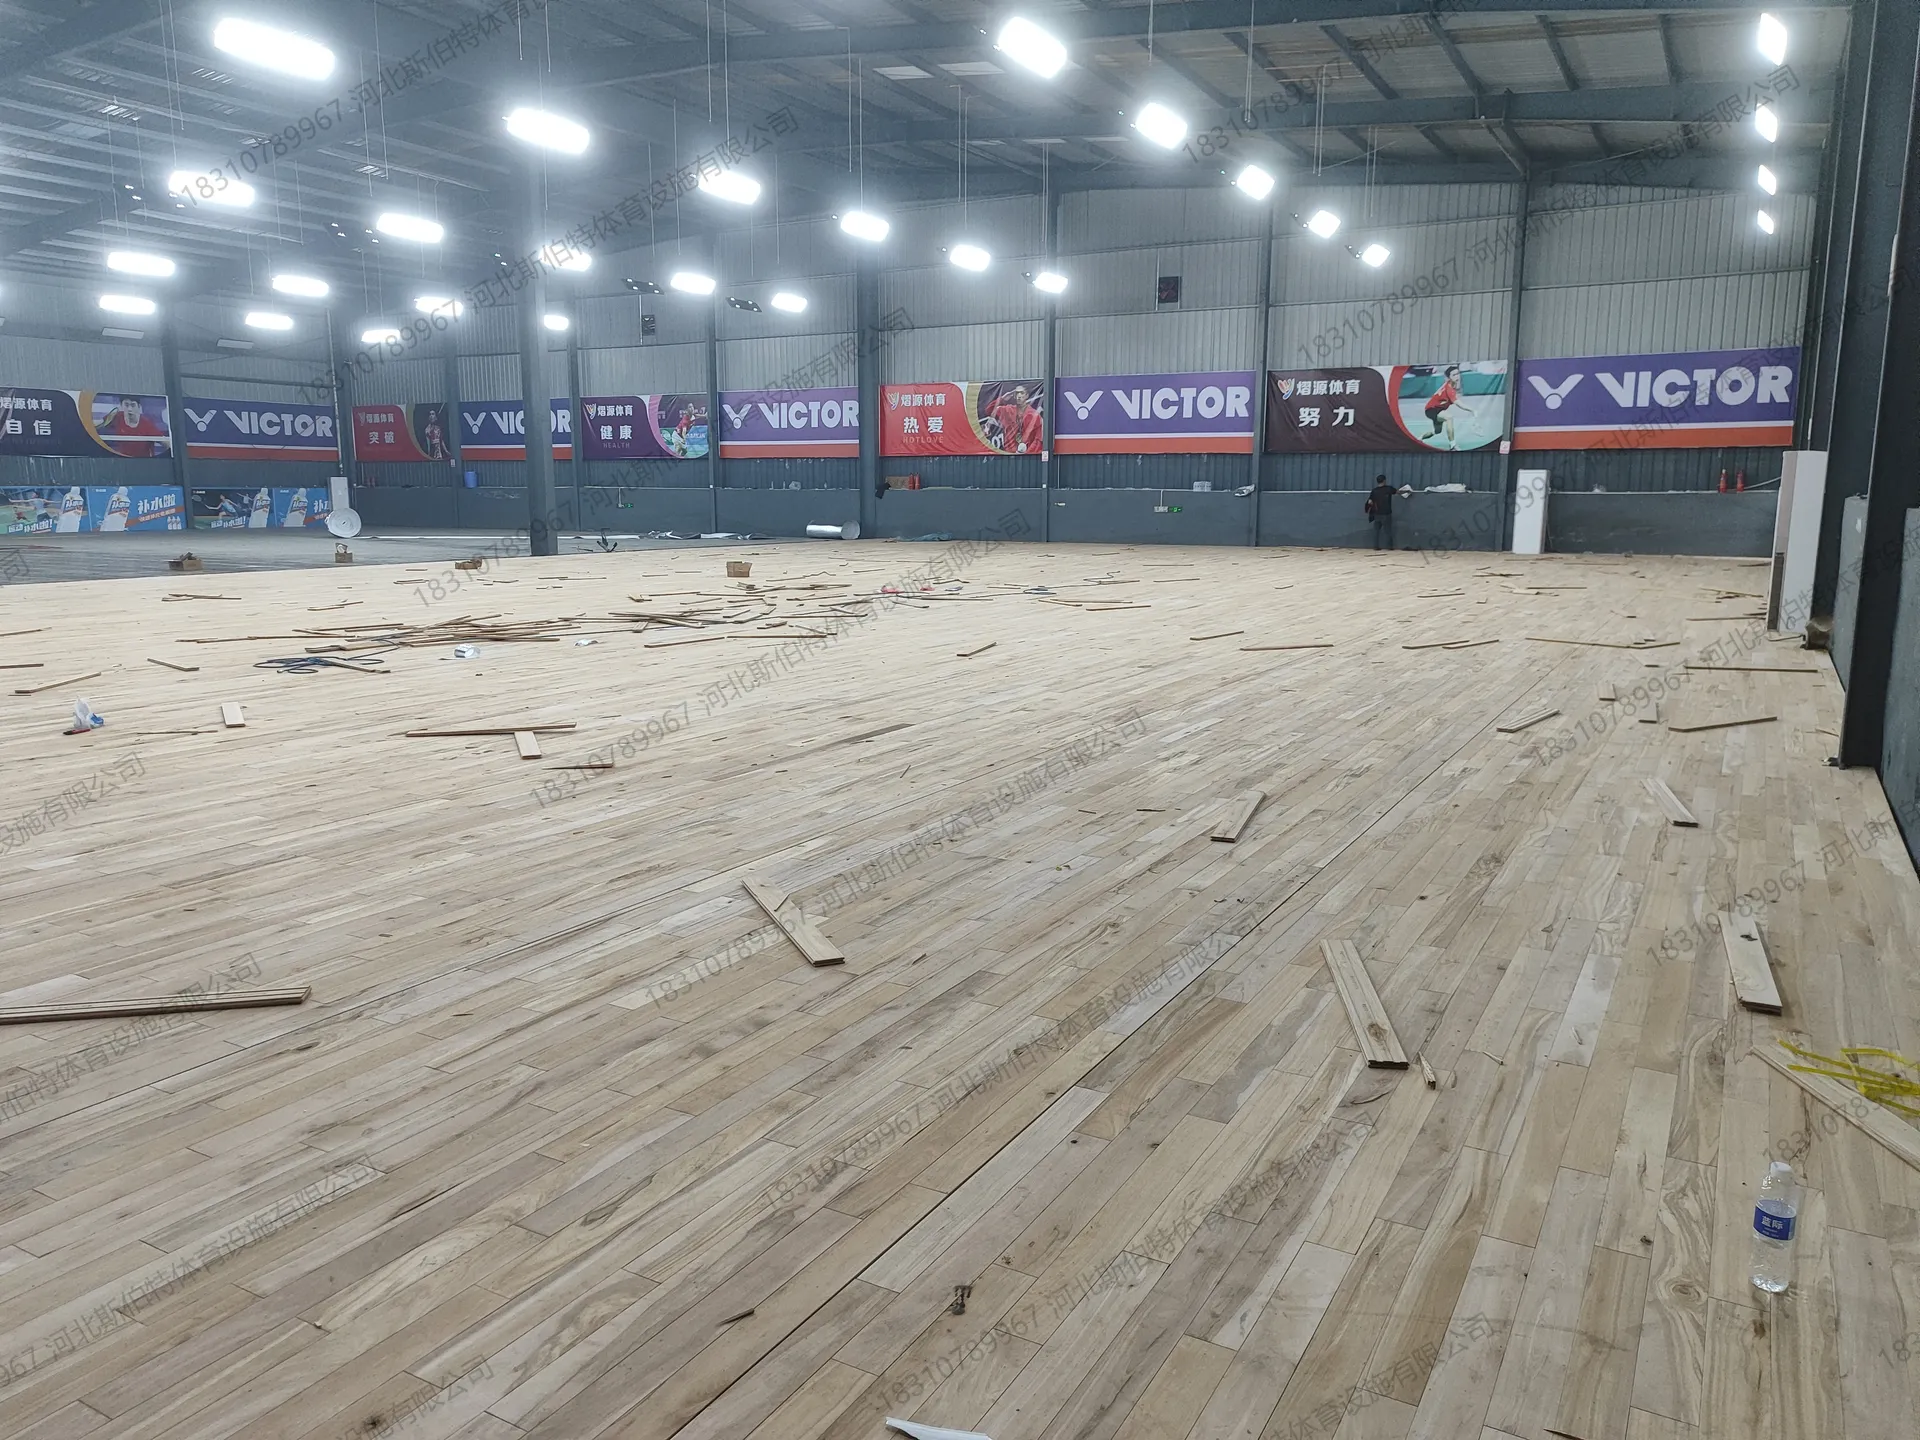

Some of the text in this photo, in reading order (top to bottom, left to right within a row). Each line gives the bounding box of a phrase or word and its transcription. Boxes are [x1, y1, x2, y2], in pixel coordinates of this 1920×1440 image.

[1595, 365, 1793, 408] VICTOR
[758, 400, 859, 429] VICTOR
[1111, 386, 1251, 420] VICTOR
[6, 419, 52, 436] 自信
[223, 410, 334, 437] VICTOR
[491, 409, 572, 435] VICR
[903, 416, 944, 434] 热爱
[1298, 406, 1355, 428] 努力
[369, 431, 395, 444] 突破
[600, 425, 633, 440] 健康
